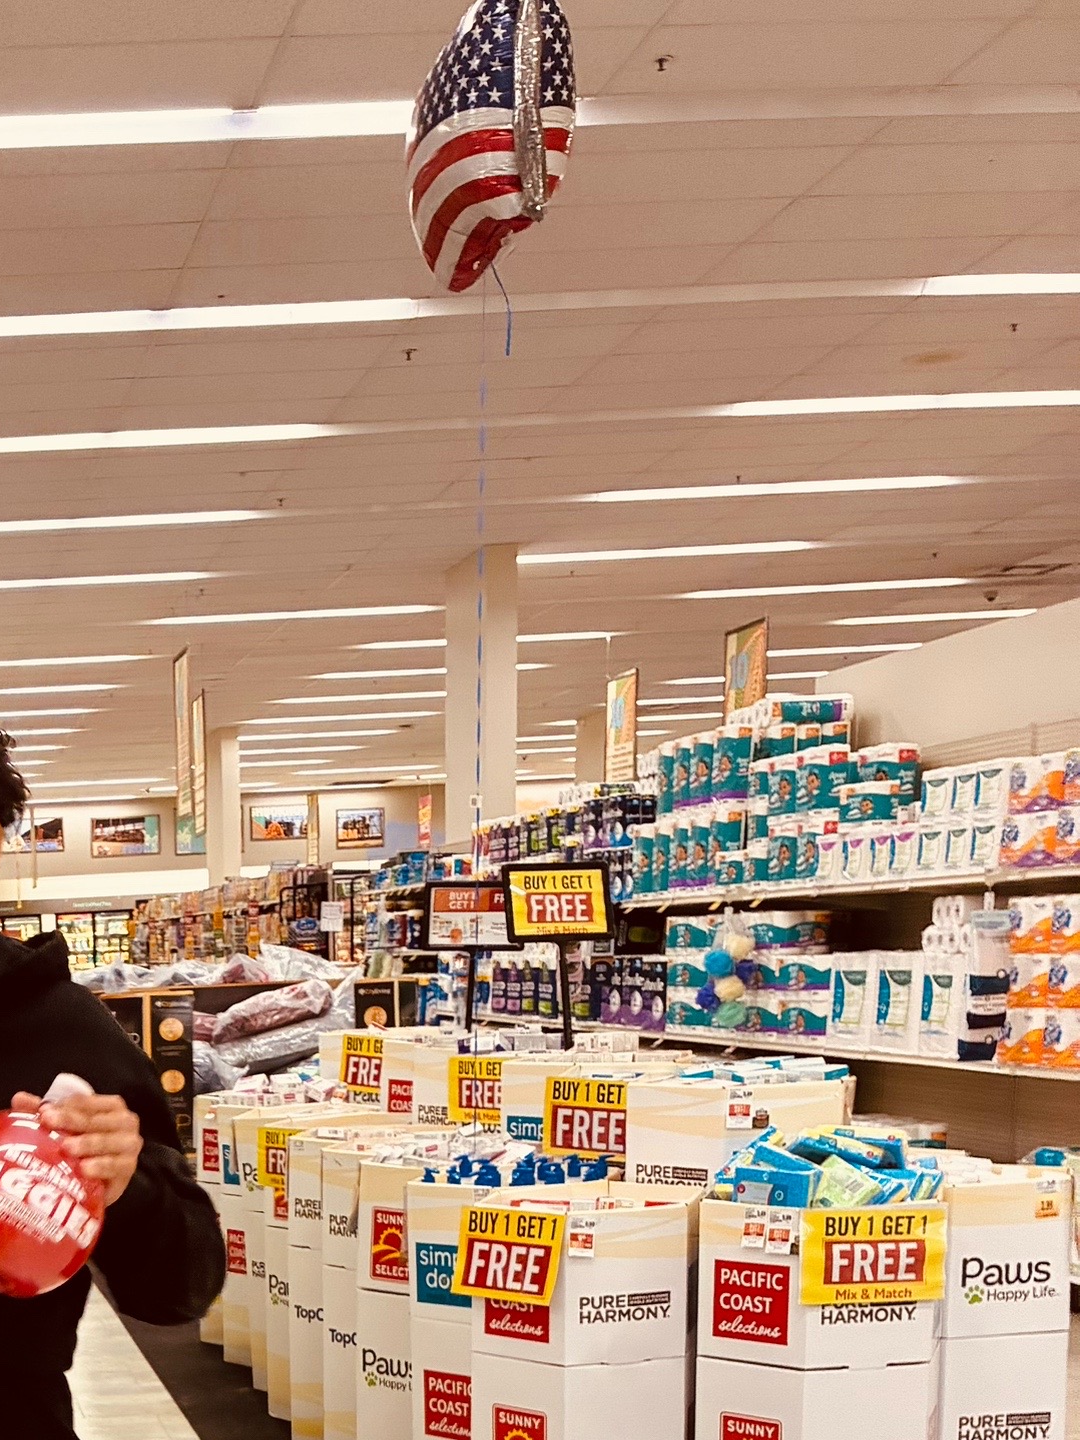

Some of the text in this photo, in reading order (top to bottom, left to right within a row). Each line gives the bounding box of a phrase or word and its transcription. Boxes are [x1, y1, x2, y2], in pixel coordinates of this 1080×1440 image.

[523, 875, 593, 890] BUY 1 GET 1
[449, 891, 467, 900] BUY
[530, 894, 589, 922] FREE
[346, 1037, 363, 1052] BUY
[458, 1061, 475, 1075] BUY
[486, 1062, 502, 1076] GET
[461, 1080, 502, 1109] FREE
[552, 1081, 625, 1104] BUY 1 GET
[418, 1104, 441, 1116] PURE
[265, 1131, 280, 1144] BUY
[556, 1108, 624, 1152] FREE
[635, 1164, 670, 1177] PURE
[376, 1213, 403, 1226] SUNN
[468, 1211, 498, 1233] BUY
[504, 1214, 510, 1235] 1
[517, 1215, 547, 1240] GET
[551, 1218, 557, 1240] 1
[825, 1215, 928, 1236] BUY 1 GET 1
[467, 1241, 545, 1293] FREE
[831, 1241, 917, 1282] FREE
[720, 1268, 784, 1291] PACIFIC
[960, 1257, 1051, 1288] Paws
[579, 1295, 626, 1310] PURE
[835, 1288, 912, 1300] Mix & Match
[987, 1288, 1030, 1303] Happy
[719, 1293, 773, 1315] COAST
[579, 1305, 670, 1324] HARMONY
[821, 1306, 915, 1325] HARMONY
[489, 1316, 543, 1337] selections
[718, 1315, 782, 1339] selections
[429, 1398, 469, 1417] COAST
[499, 1411, 541, 1430] SUNNY
[727, 1419, 775, 1439] SUNNY
[958, 1415, 1005, 1429] PURE
